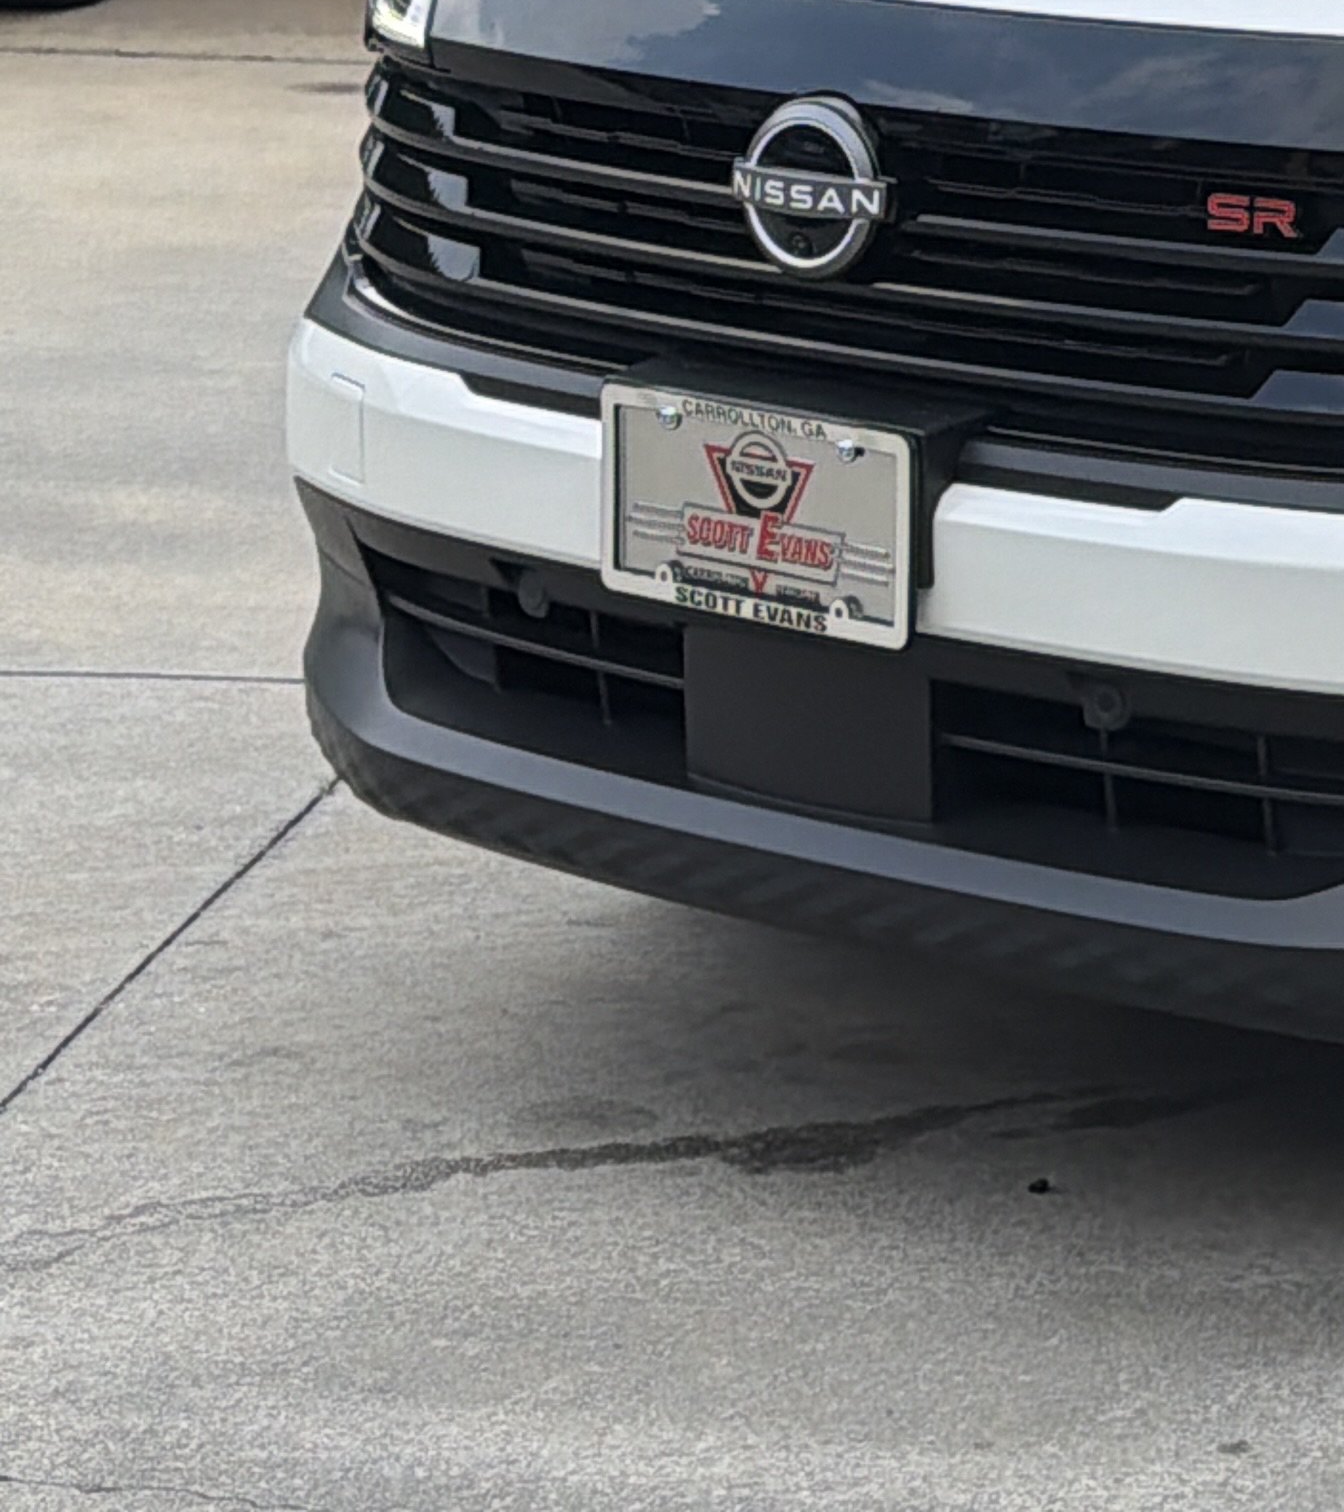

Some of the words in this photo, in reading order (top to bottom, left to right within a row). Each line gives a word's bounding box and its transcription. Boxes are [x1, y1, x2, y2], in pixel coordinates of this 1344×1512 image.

[733, 170, 880, 215] NISSAN
[1207, 192, 1299, 238] SR
[801, 420, 827, 438] GA
[730, 459, 788, 482] NISSAN
[687, 513, 753, 554] SCOTT
[756, 510, 834, 571] EVANS
[675, 586, 747, 617] SCOTT
[753, 602, 828, 633] EVANS
